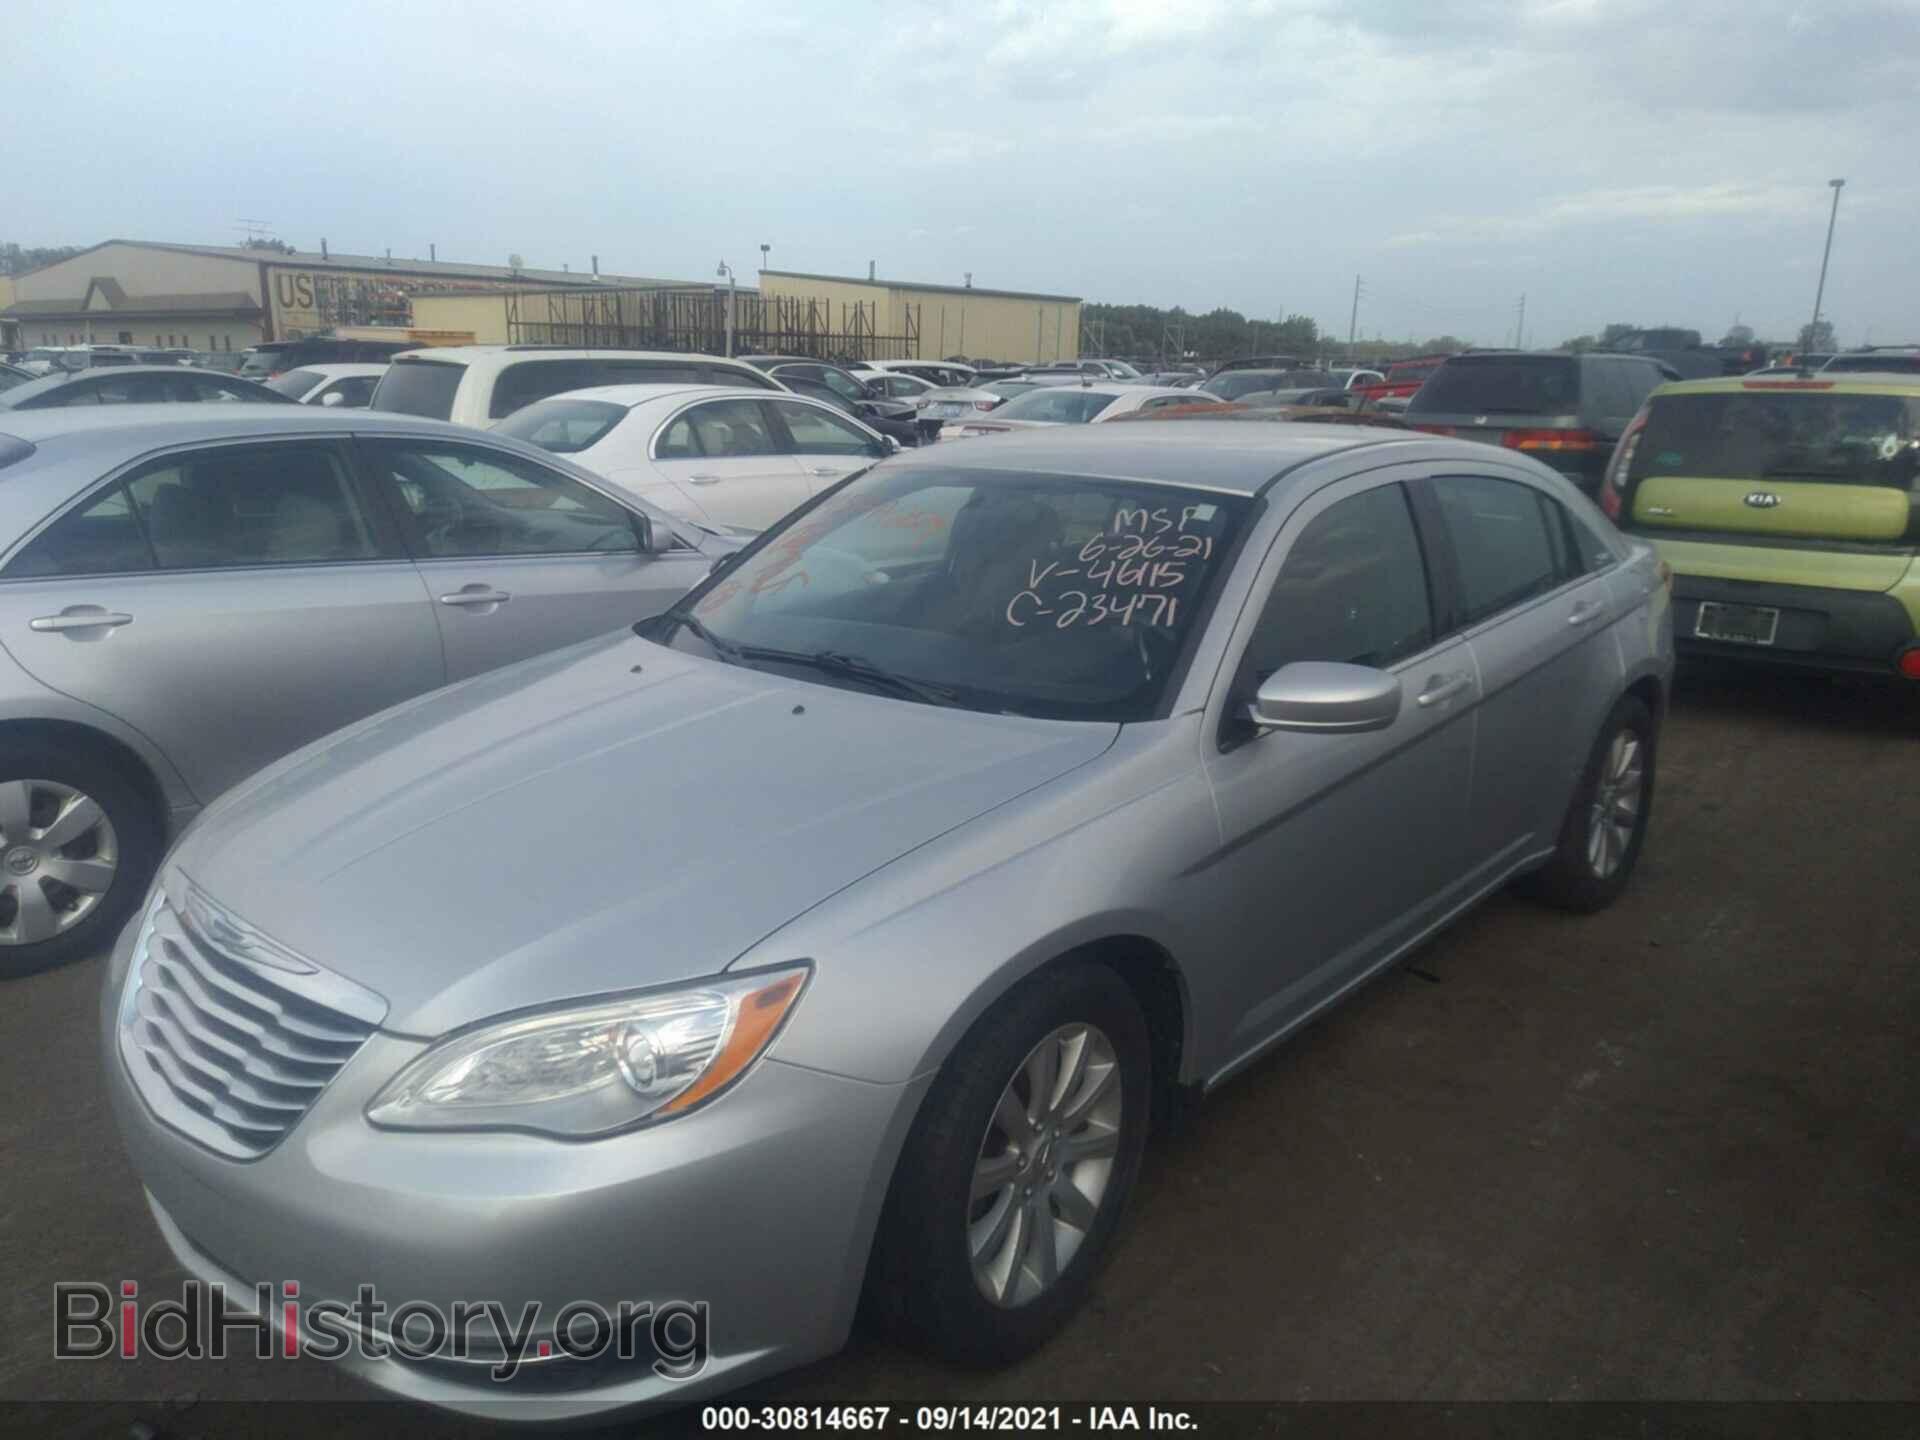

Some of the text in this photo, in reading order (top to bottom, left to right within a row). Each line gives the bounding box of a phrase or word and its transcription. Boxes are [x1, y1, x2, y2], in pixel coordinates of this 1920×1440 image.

[1747, 493, 1775, 505] KIA
[1078, 531, 1213, 562] 6-26-21
[1006, 590, 1178, 629] C-23471
